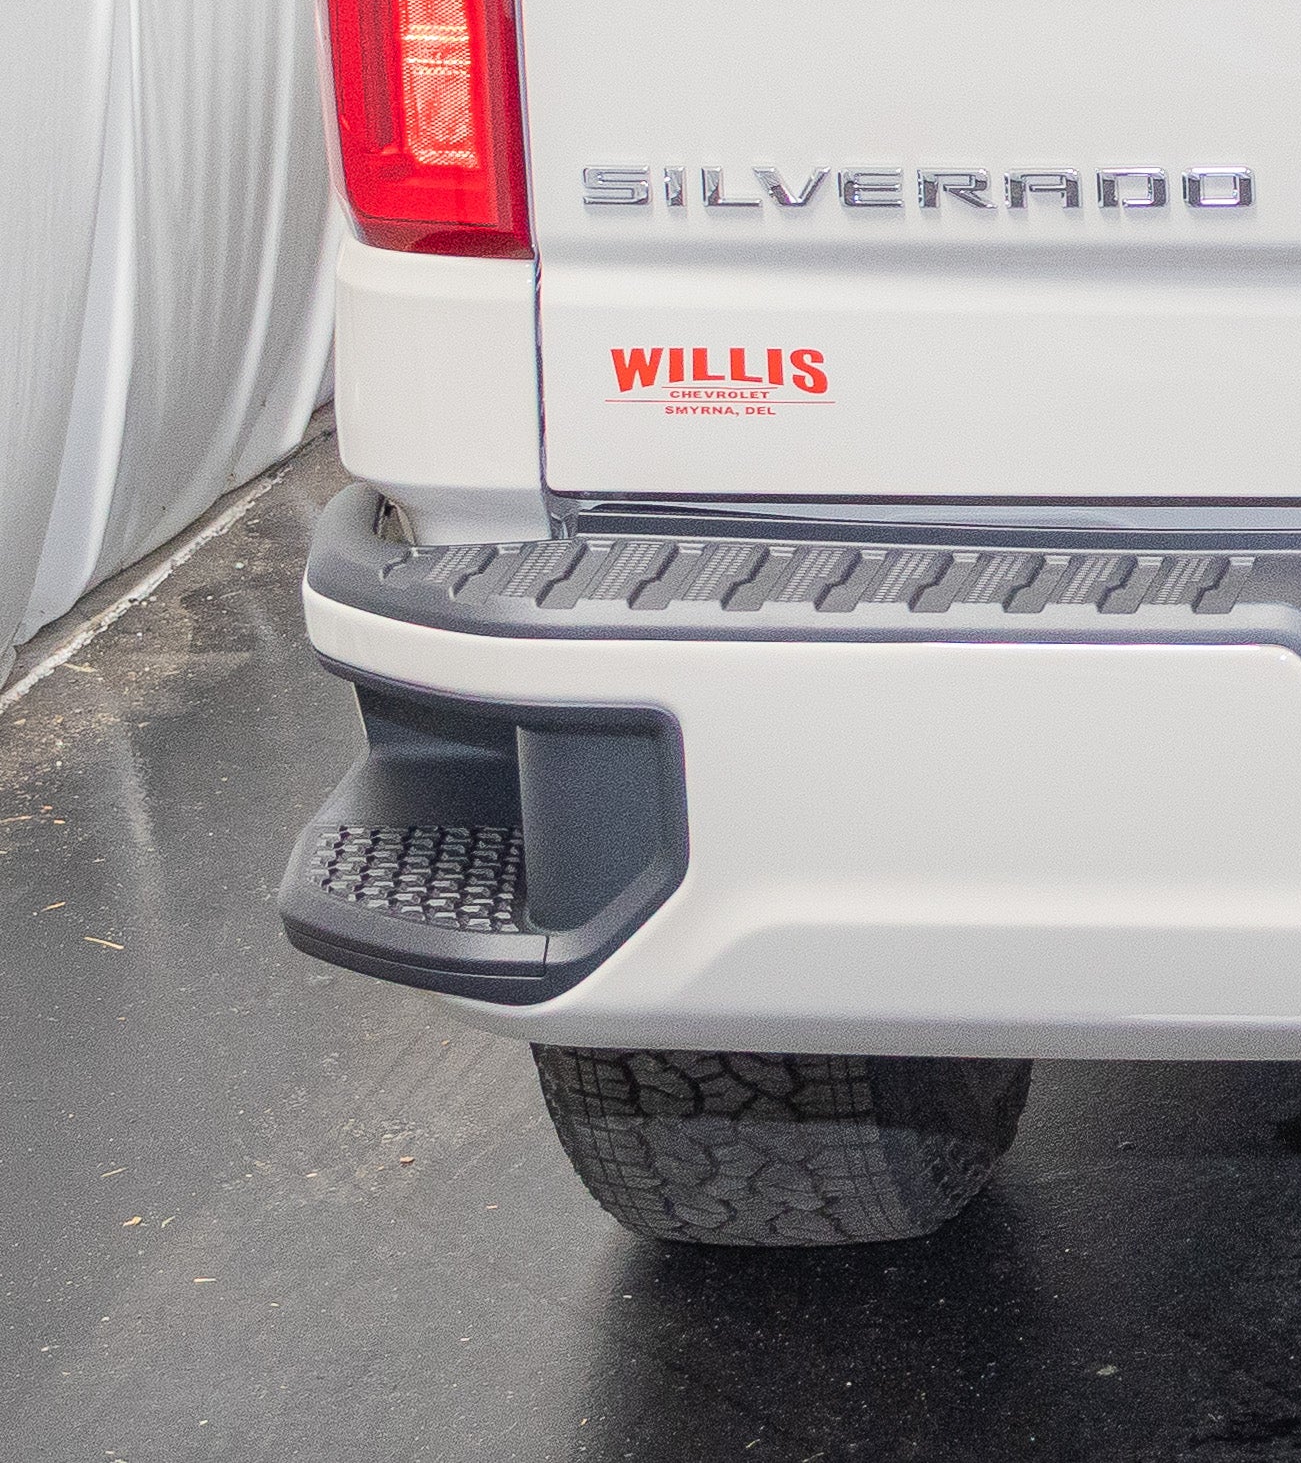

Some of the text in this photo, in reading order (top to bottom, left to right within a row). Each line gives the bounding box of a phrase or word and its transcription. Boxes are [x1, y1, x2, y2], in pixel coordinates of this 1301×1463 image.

[583, 164, 1255, 209] SILVERADO
[610, 347, 828, 394] WILLIS
[669, 390, 769, 399] CHEVROLET
[665, 406, 776, 417] SMYRNA, DEL
